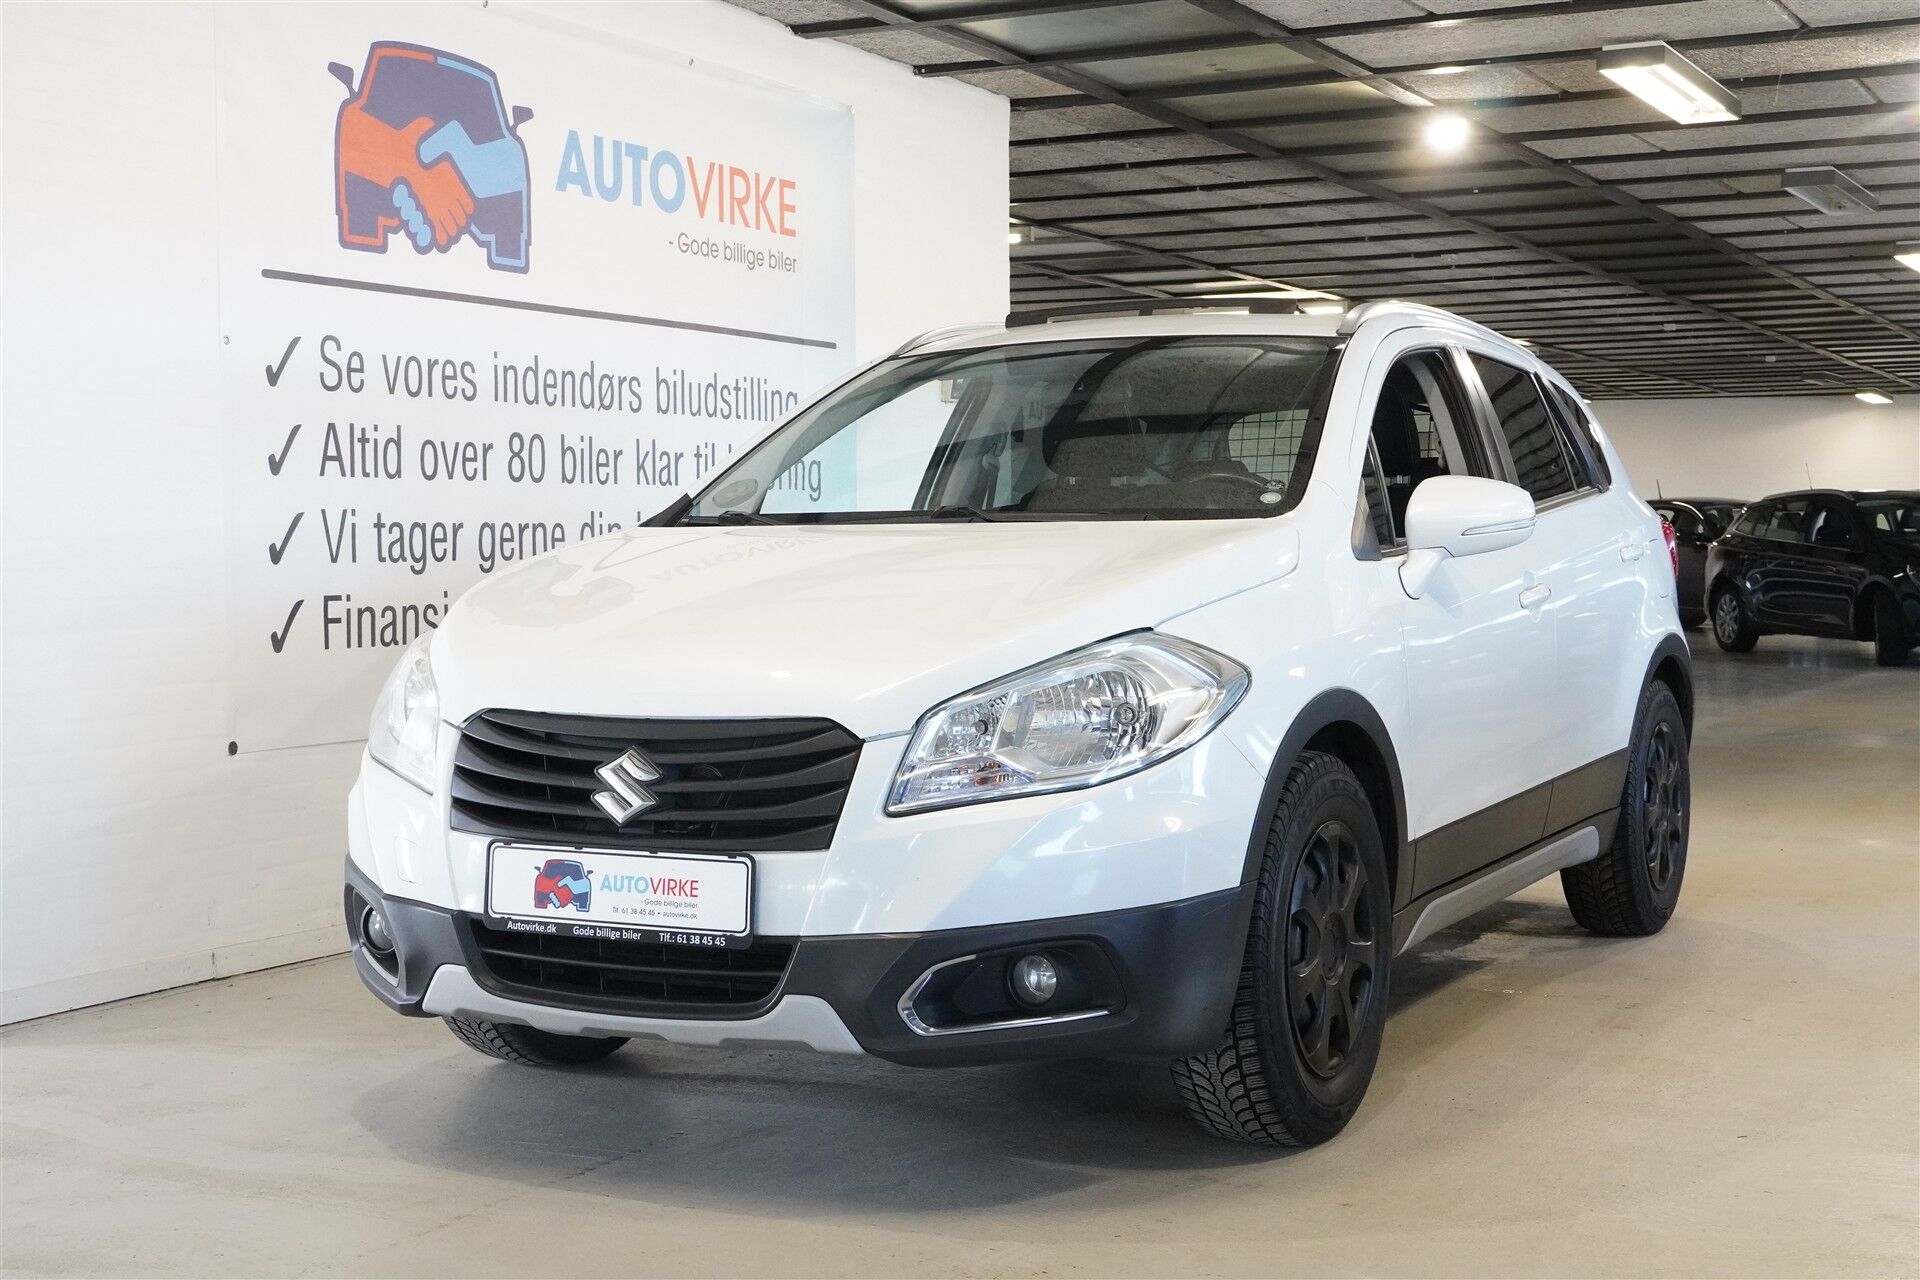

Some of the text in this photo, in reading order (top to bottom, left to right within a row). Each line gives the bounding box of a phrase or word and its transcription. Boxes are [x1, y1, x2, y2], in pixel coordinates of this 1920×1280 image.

[555, 129, 797, 239] AUTOVIRKE
[677, 232, 719, 258] Gode
[724, 239, 764, 271] billige
[768, 247, 797, 273] biler
[320, 334, 365, 394] Se
[381, 354, 477, 402] vores
[493, 351, 642, 414] indendørs
[319, 422, 402, 480] Altid
[419, 439, 494, 483] over
[507, 431, 546, 484] 80
[560, 433, 624, 486] biler
[635, 438, 684, 487] klar
[320, 508, 358, 564] Vi
[372, 512, 464, 576] tager
[478, 521, 566, 575] gerne
[600, 874, 699, 898] AUTOVIRKE
[644, 898, 698, 909] Gode billige biler
[507, 920, 726, 947] Autovirke.dk Gode billige biler Tlf.: 61 38 45 45
[639, 908, 647, 916] 45
[648, 909, 656, 917] 45
[662, 911, 698, 920] autovirke.dk
